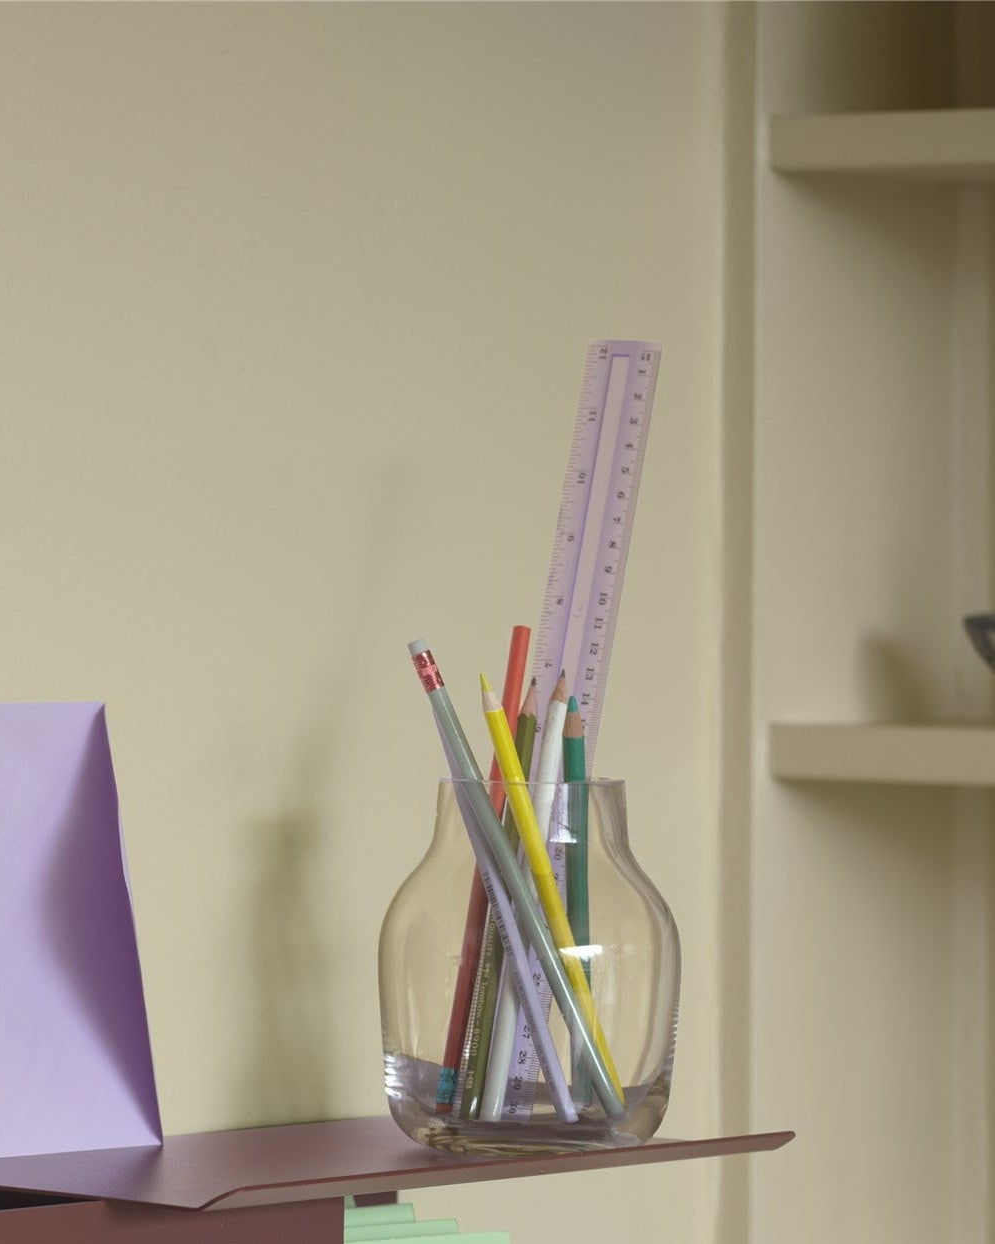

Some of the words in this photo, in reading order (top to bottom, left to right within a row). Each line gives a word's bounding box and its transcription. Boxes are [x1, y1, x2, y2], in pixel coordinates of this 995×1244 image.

[598, 347, 608, 360] 12
[633, 392, 643, 400] 2
[588, 411, 597, 421] 11
[629, 417, 638, 425] 3
[621, 466, 629, 474] 5
[577, 472, 586, 484] 10
[604, 565, 613, 573] 9
[598, 592, 608, 606] 10
[593, 617, 604, 629] 11
[589, 642, 599, 656] 12
[585, 667, 595, 681] 13
[580, 693, 591, 706] 14
[476, 982, 488, 1018] Tombow
[522, 1024, 531, 1039] 27
[518, 1050, 528, 1065] 28
[465, 1070, 475, 1089] HB
